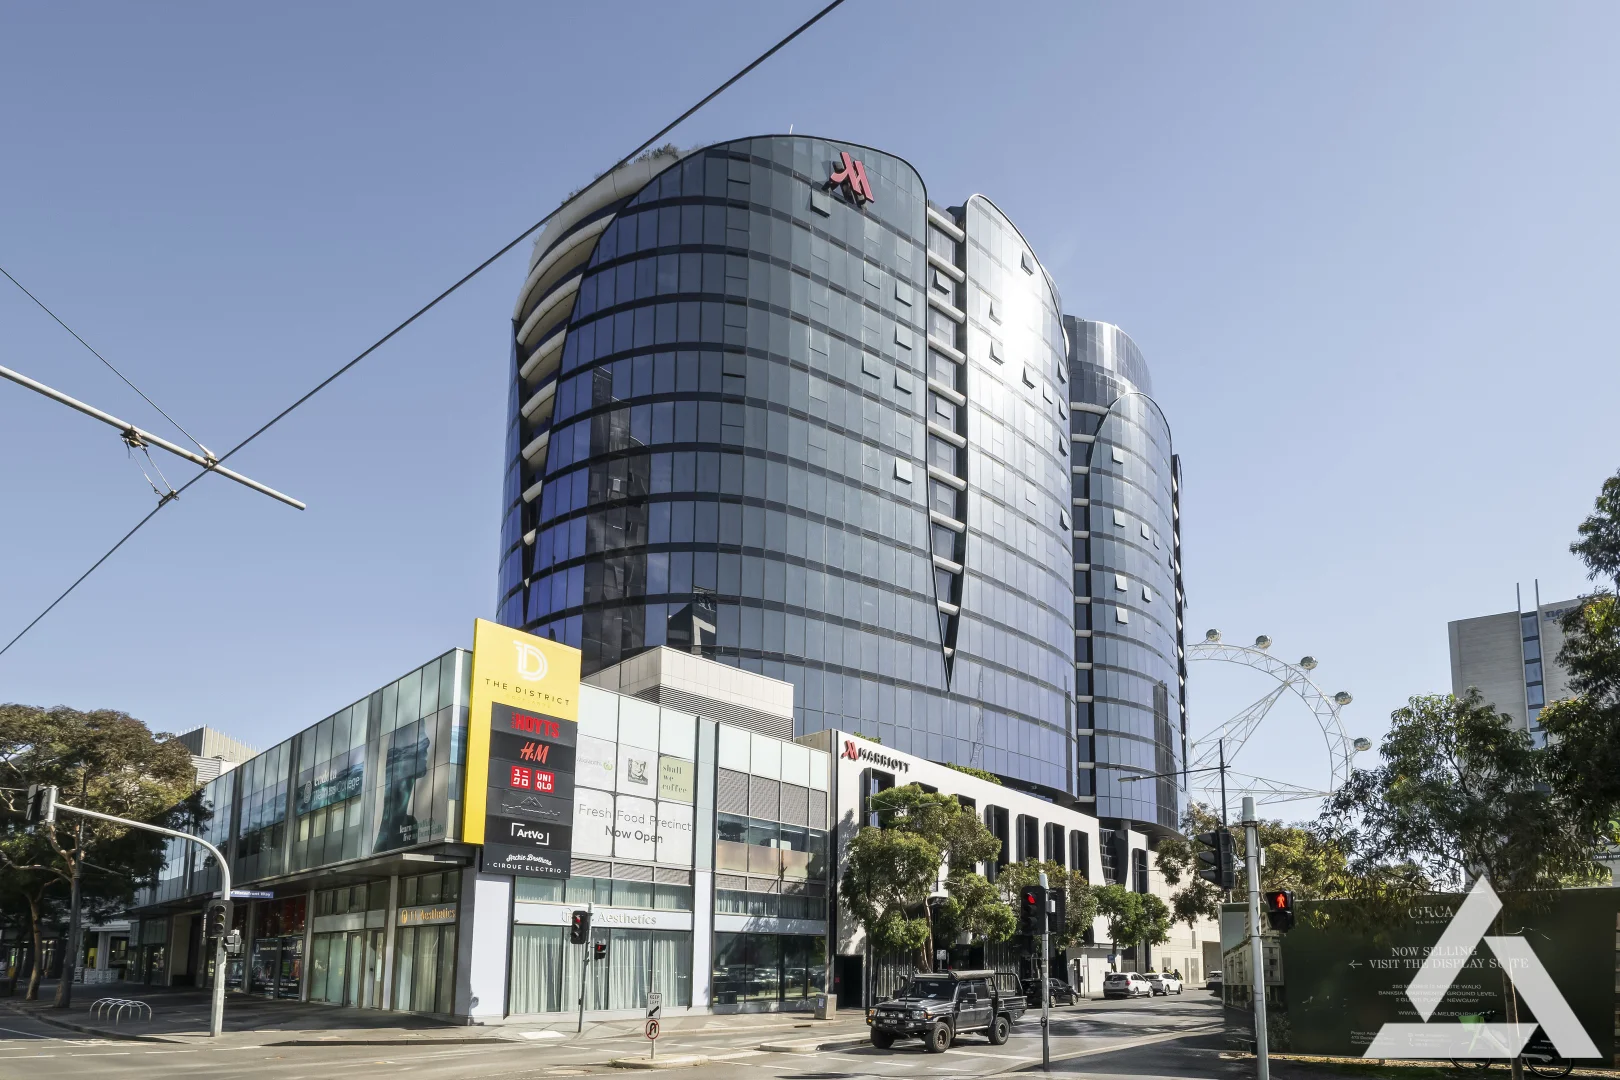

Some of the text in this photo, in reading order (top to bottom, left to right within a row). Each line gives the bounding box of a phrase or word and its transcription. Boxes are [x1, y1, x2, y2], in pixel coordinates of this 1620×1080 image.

[485, 678, 508, 690] THE
[515, 686, 570, 706] DISTRICT
[515, 713, 560, 739] HOYTS
[520, 741, 550, 764] H&M
[858, 747, 910, 774] MARRIOTT
[663, 764, 682, 775] shall
[537, 773, 551, 783] UNI
[536, 781, 552, 790] QLO
[579, 803, 612, 819] Fresh
[617, 810, 645, 825] Food
[650, 815, 692, 832] Precinct
[516, 828, 544, 840] ArtVo
[605, 825, 663, 843] Now Open
[506, 853, 553, 866] Archie Brothers
[420, 908, 456, 920] Aesthetics
[598, 912, 657, 925] Aesthetics
[1391, 945, 1478, 957] NOW SELLING
[1369, 959, 1401, 969] VISIT
[1404, 959, 1429, 968] THE
[1433, 958, 1485, 969] DISPLAY
